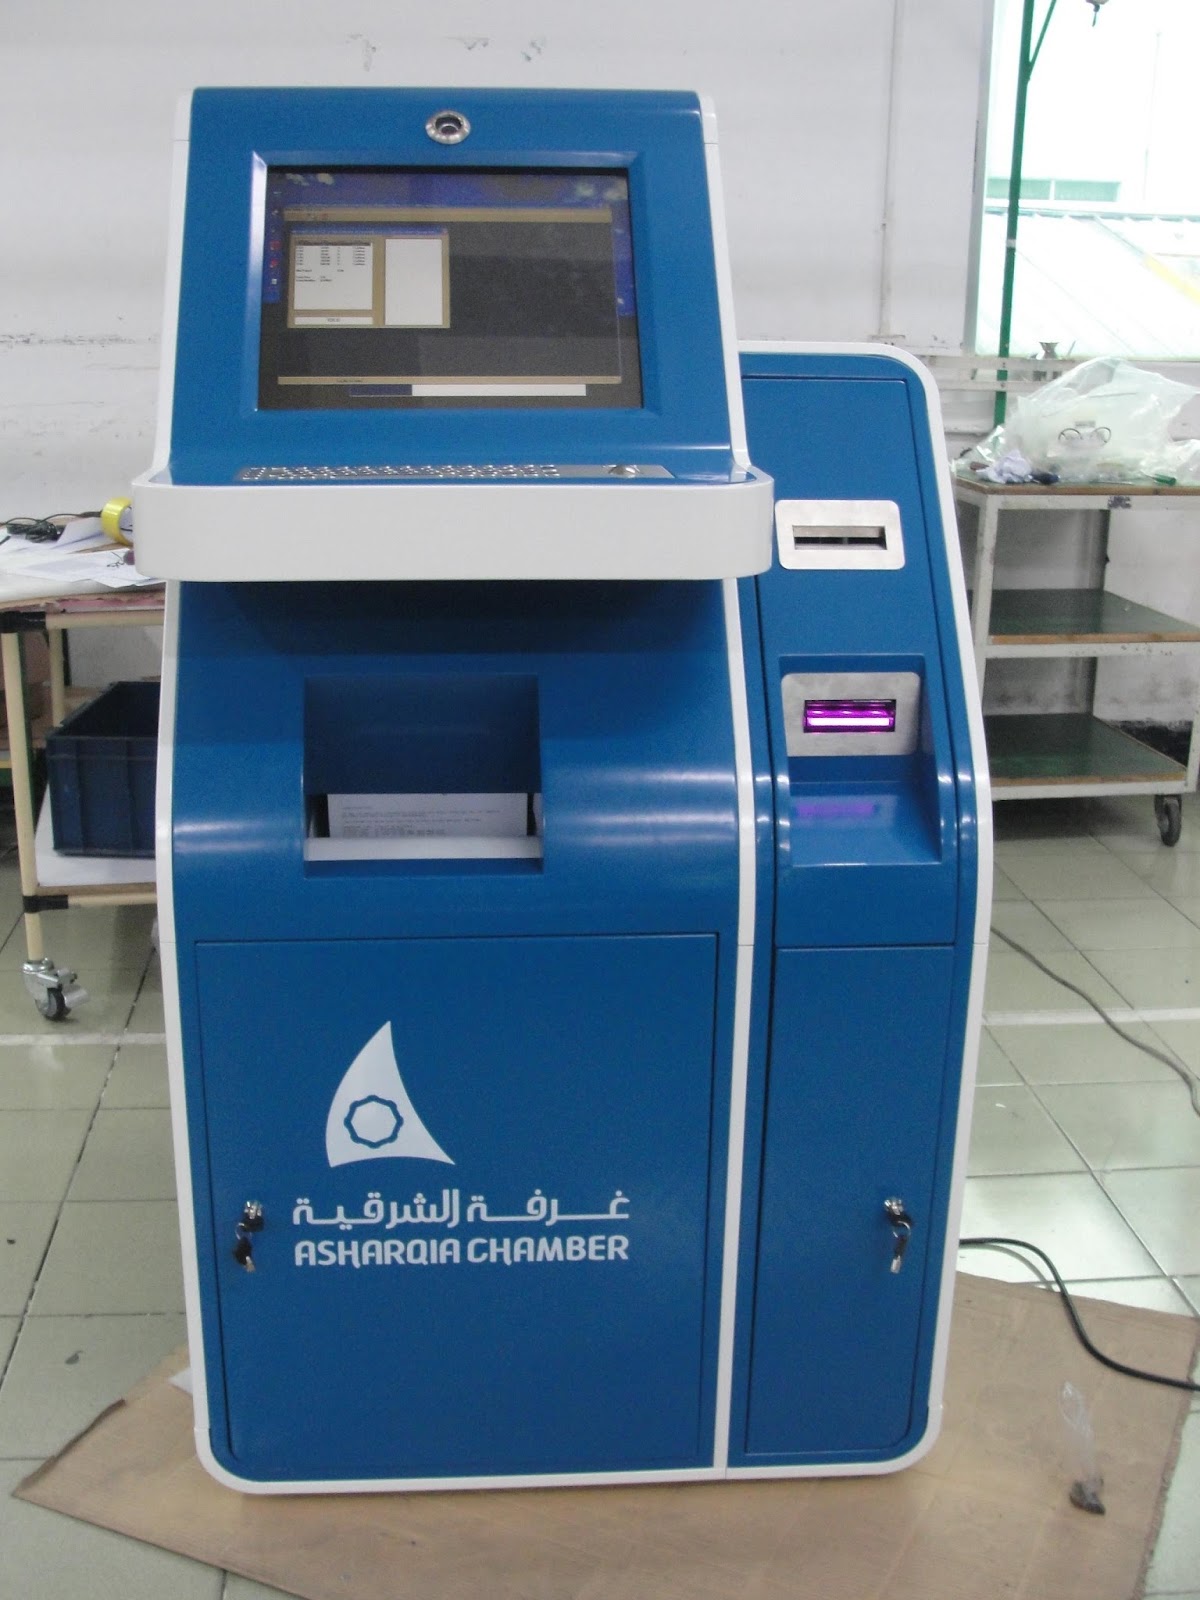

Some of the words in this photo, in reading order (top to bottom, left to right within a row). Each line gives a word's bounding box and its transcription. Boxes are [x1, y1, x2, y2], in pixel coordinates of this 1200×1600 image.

[293, 1189, 459, 1230] الشرقية
[467, 1189, 629, 1226] غرفة
[295, 1239, 460, 1268] ASHARQIA
[467, 1235, 629, 1265] CHAMBER
